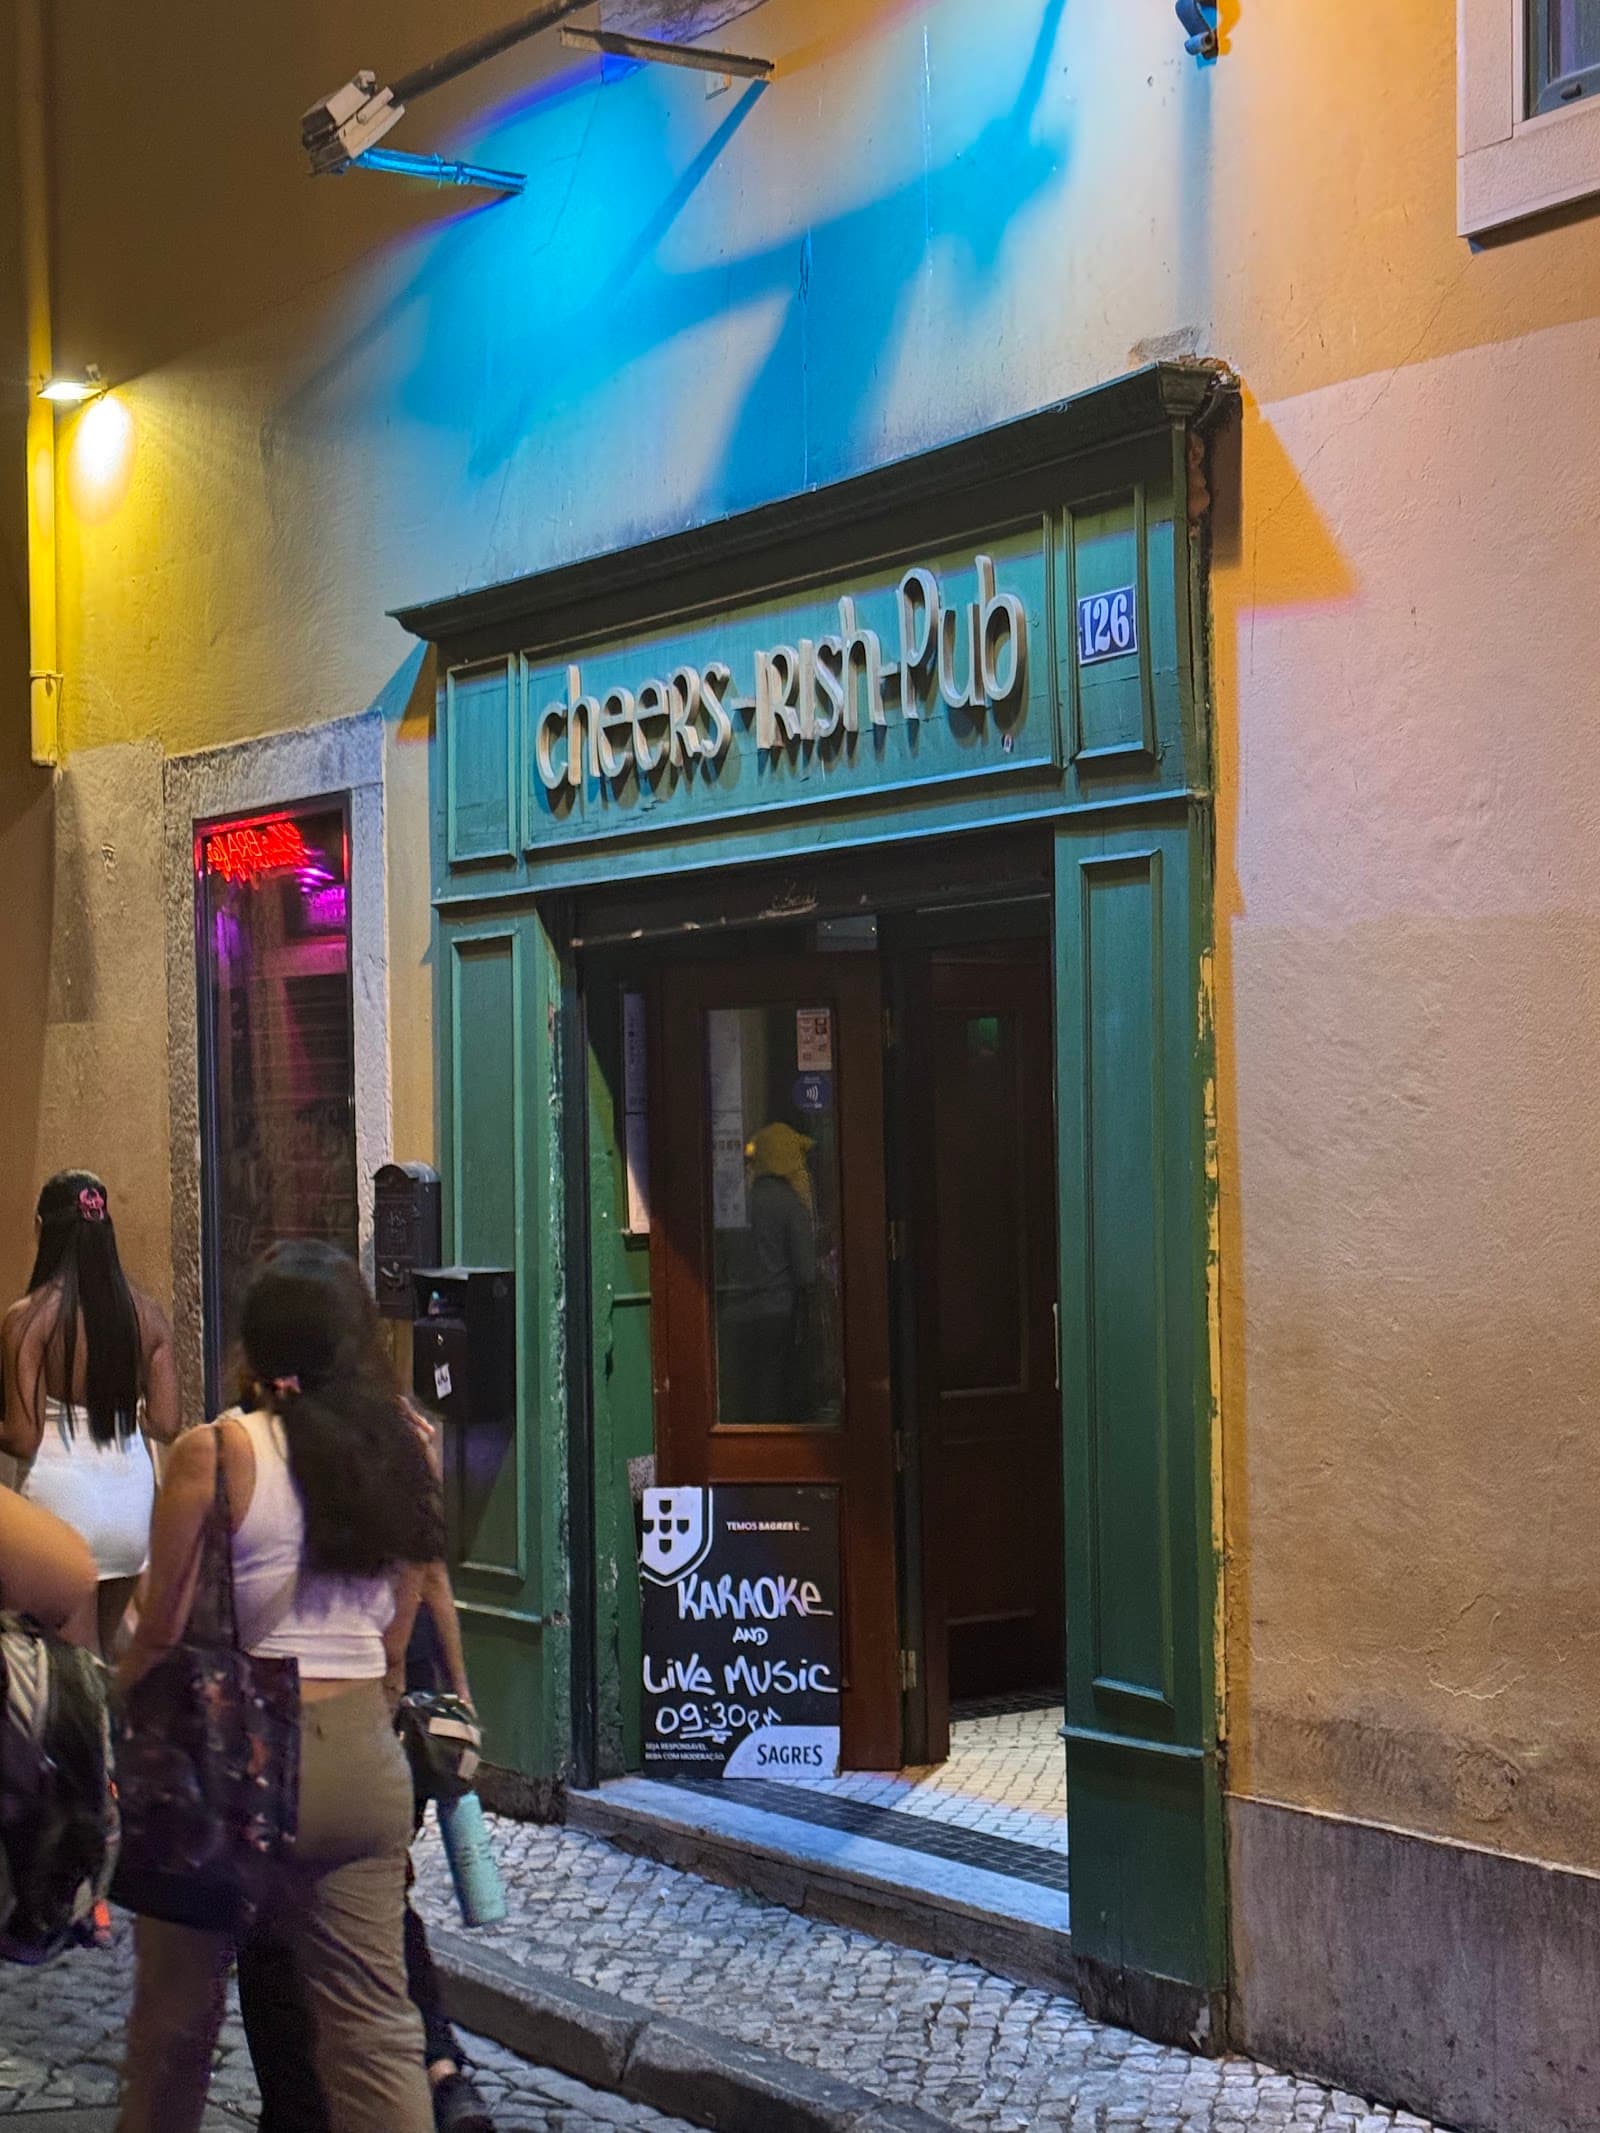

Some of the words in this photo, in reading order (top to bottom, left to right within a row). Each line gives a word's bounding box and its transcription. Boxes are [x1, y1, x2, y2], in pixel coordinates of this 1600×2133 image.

[1081, 592, 1131, 658] 126
[726, 1520, 757, 1532] TEMOS
[732, 1626, 769, 1646] AND
[756, 1743, 823, 1767] SAGRES
